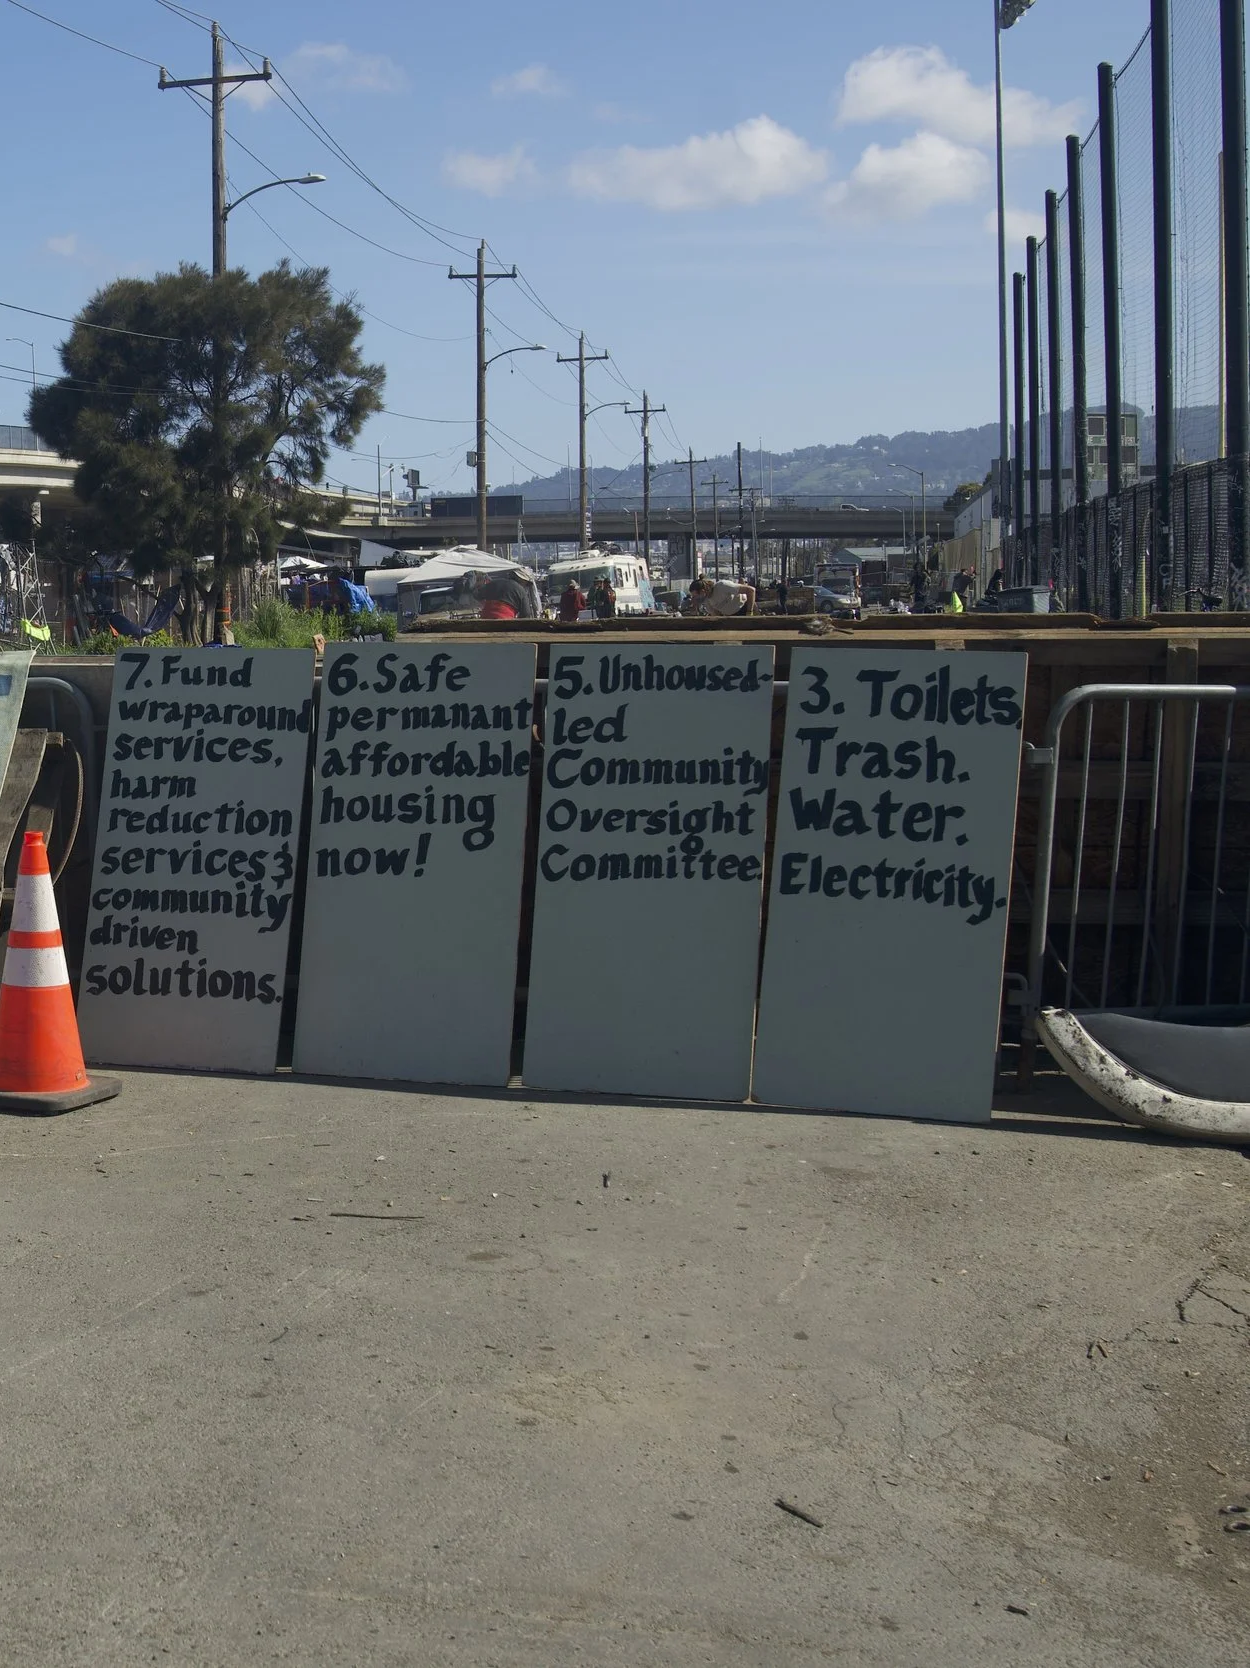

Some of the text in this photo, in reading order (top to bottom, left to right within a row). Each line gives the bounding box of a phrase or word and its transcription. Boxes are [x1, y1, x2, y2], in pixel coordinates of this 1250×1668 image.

[118, 652, 254, 690] 7. Fund
[799, 665, 845, 716] 3.
[118, 698, 313, 734] wraparound
[325, 698, 533, 742] permanant
[552, 703, 630, 747] led
[112, 729, 284, 768] services,
[321, 740, 532, 779] affordable
[795, 726, 972, 785] Trash.
[109, 769, 197, 800] harm
[546, 746, 770, 798] Community
[107, 800, 293, 838] reduction
[318, 783, 498, 853] housing
[545, 797, 757, 857] Oversight
[788, 786, 970, 848] Water.
[315, 832, 433, 878] now!
[91, 881, 293, 933] community
[778, 852, 1008, 926] Electricity.
[89, 915, 200, 956] driven
[85, 957, 283, 1005] solutions.
